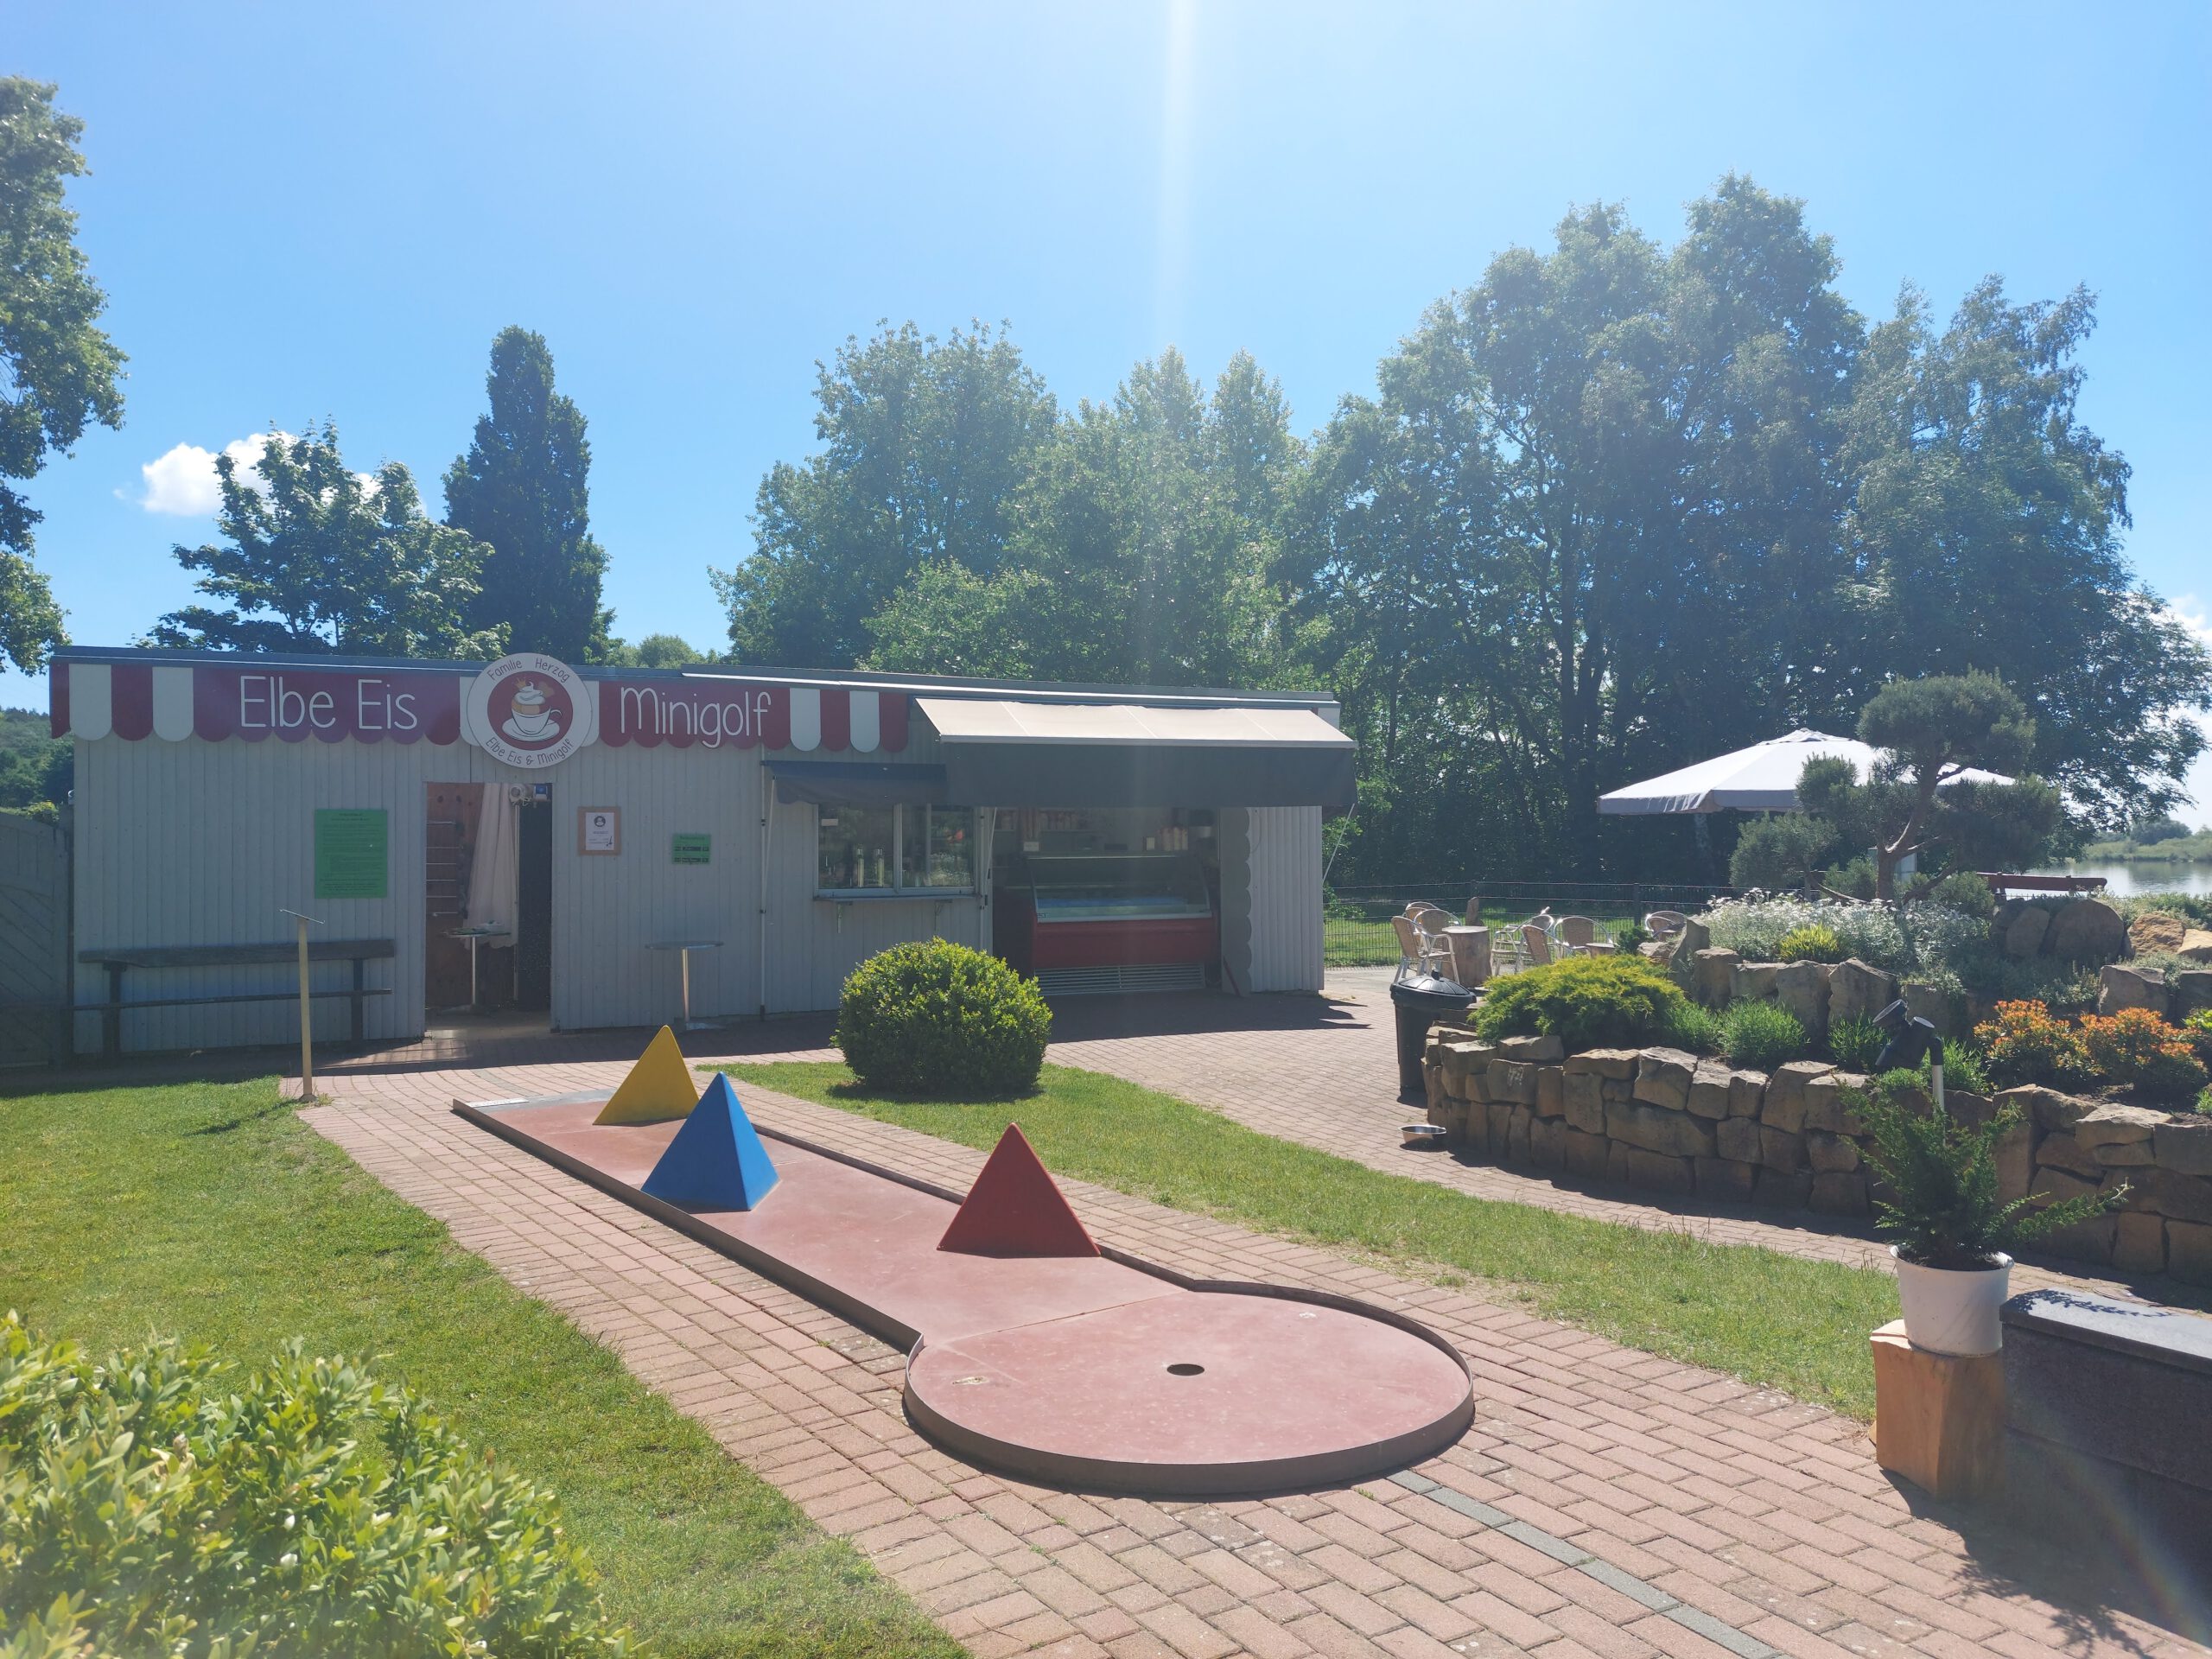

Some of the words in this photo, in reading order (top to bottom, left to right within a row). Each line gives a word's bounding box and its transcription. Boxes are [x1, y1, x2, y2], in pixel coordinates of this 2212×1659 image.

[486, 658, 523, 681] Familie
[535, 658, 570, 683] Herzog
[240, 676, 336, 728] Elbe
[358, 678, 418, 730] Eis
[620, 686, 772, 748] Minigolf
[486, 736, 505, 757] Elbe
[506, 750, 523, 765] Eis
[525, 754, 535, 766] &
[537, 738, 574, 765] Minigolf
